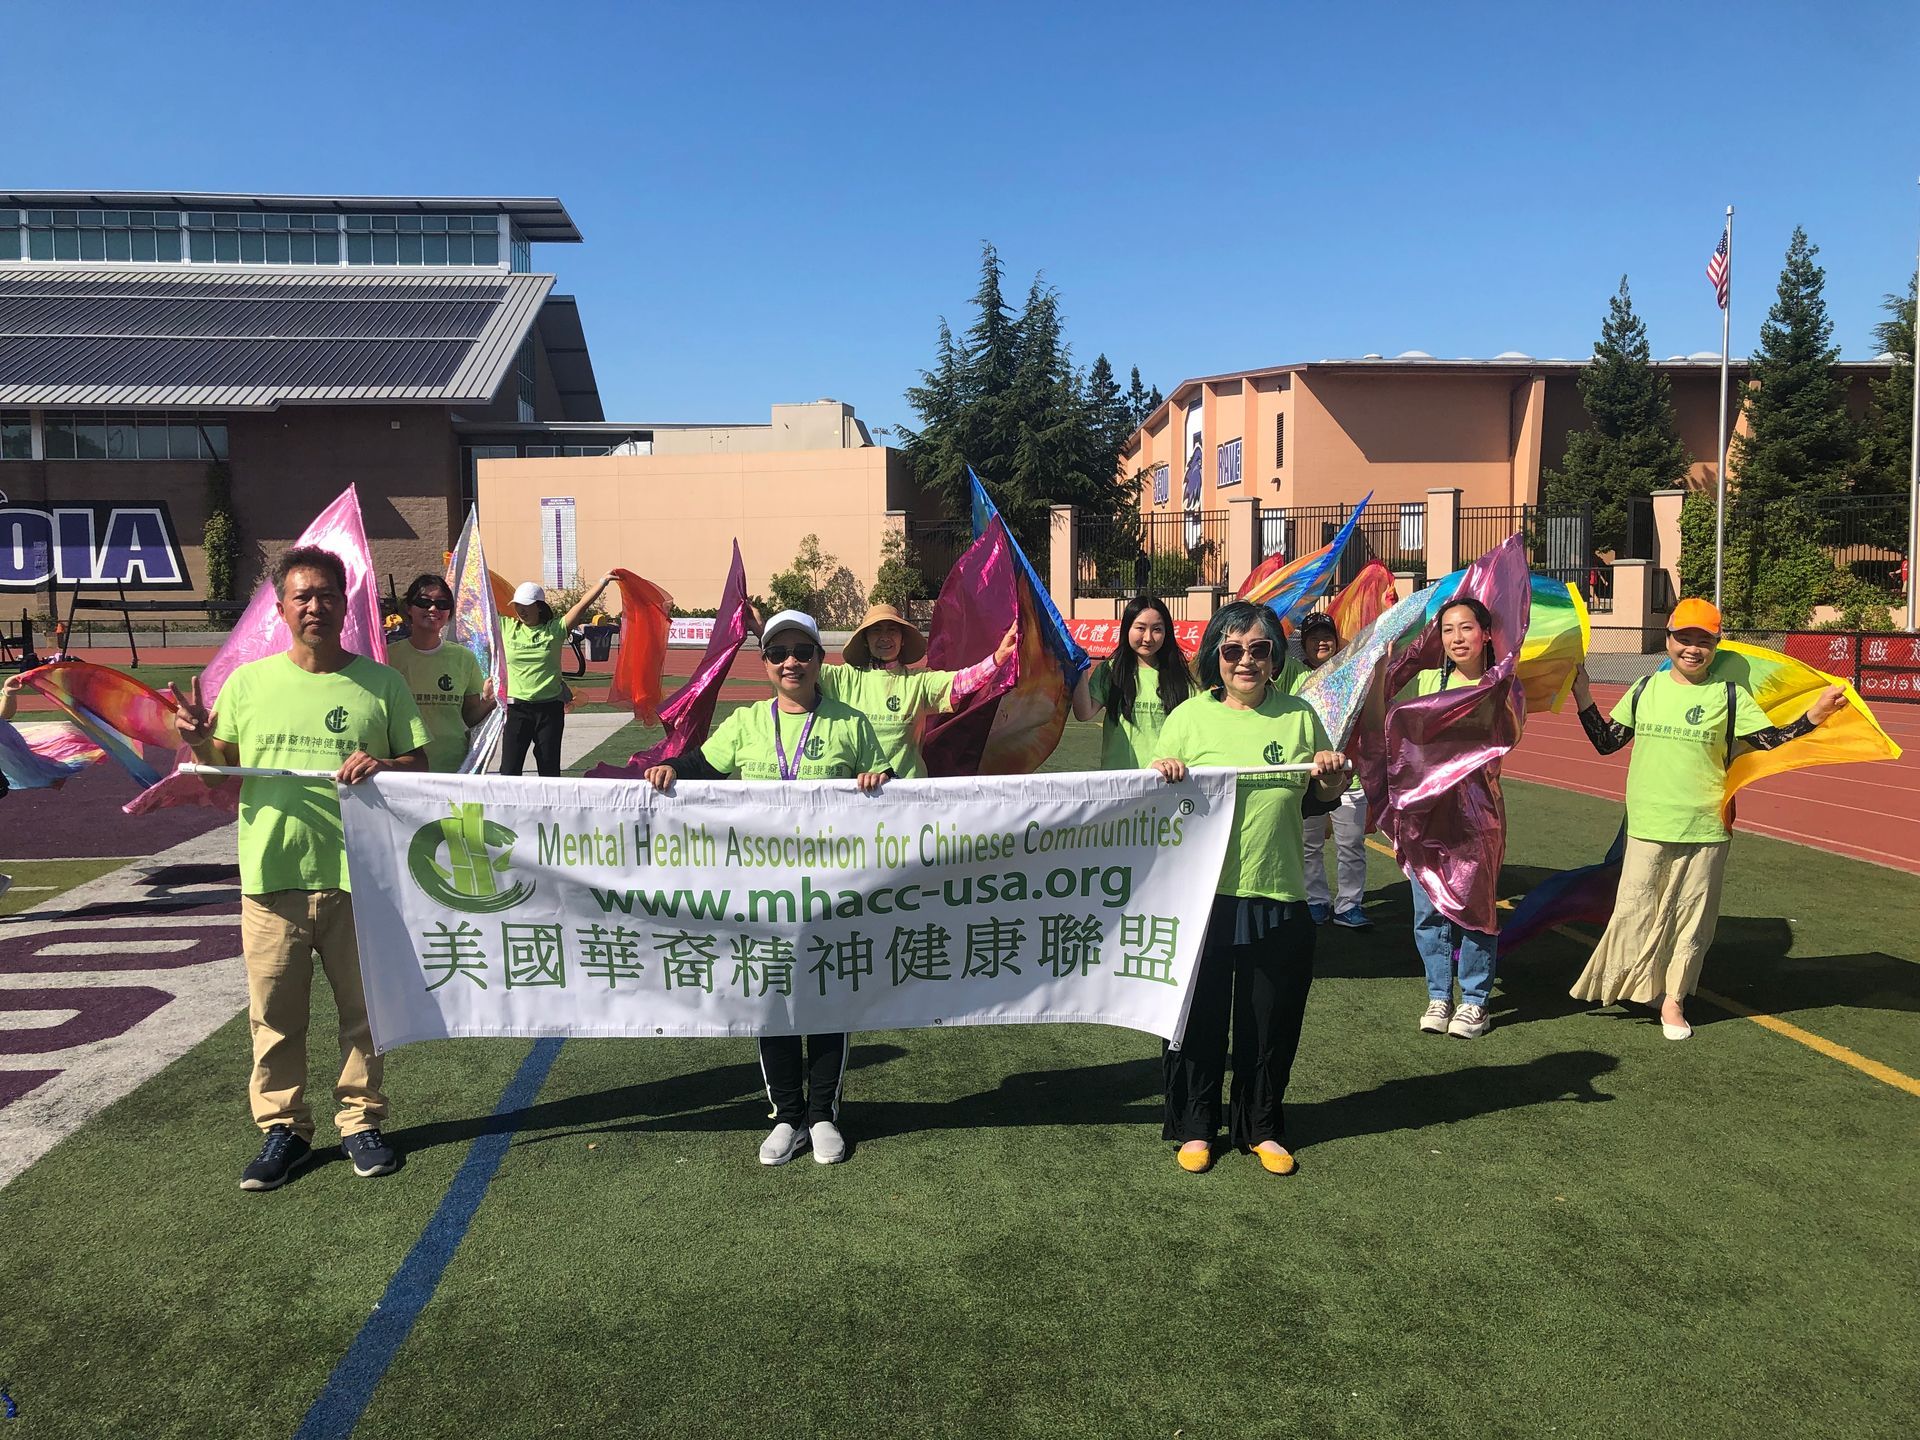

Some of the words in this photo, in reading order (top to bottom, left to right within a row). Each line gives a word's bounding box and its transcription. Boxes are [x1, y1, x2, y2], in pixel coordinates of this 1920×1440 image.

[537, 821, 626, 867] Mental
[634, 821, 717, 868] Health
[725, 825, 867, 869] Association
[875, 821, 911, 869] for
[919, 821, 1016, 867] Chinese
[1024, 806, 1184, 855] Communities
[588, 864, 1133, 923] www.mhacc-usa.org
[422, 912, 1181, 997] 美國華裔精神健康聯盟
